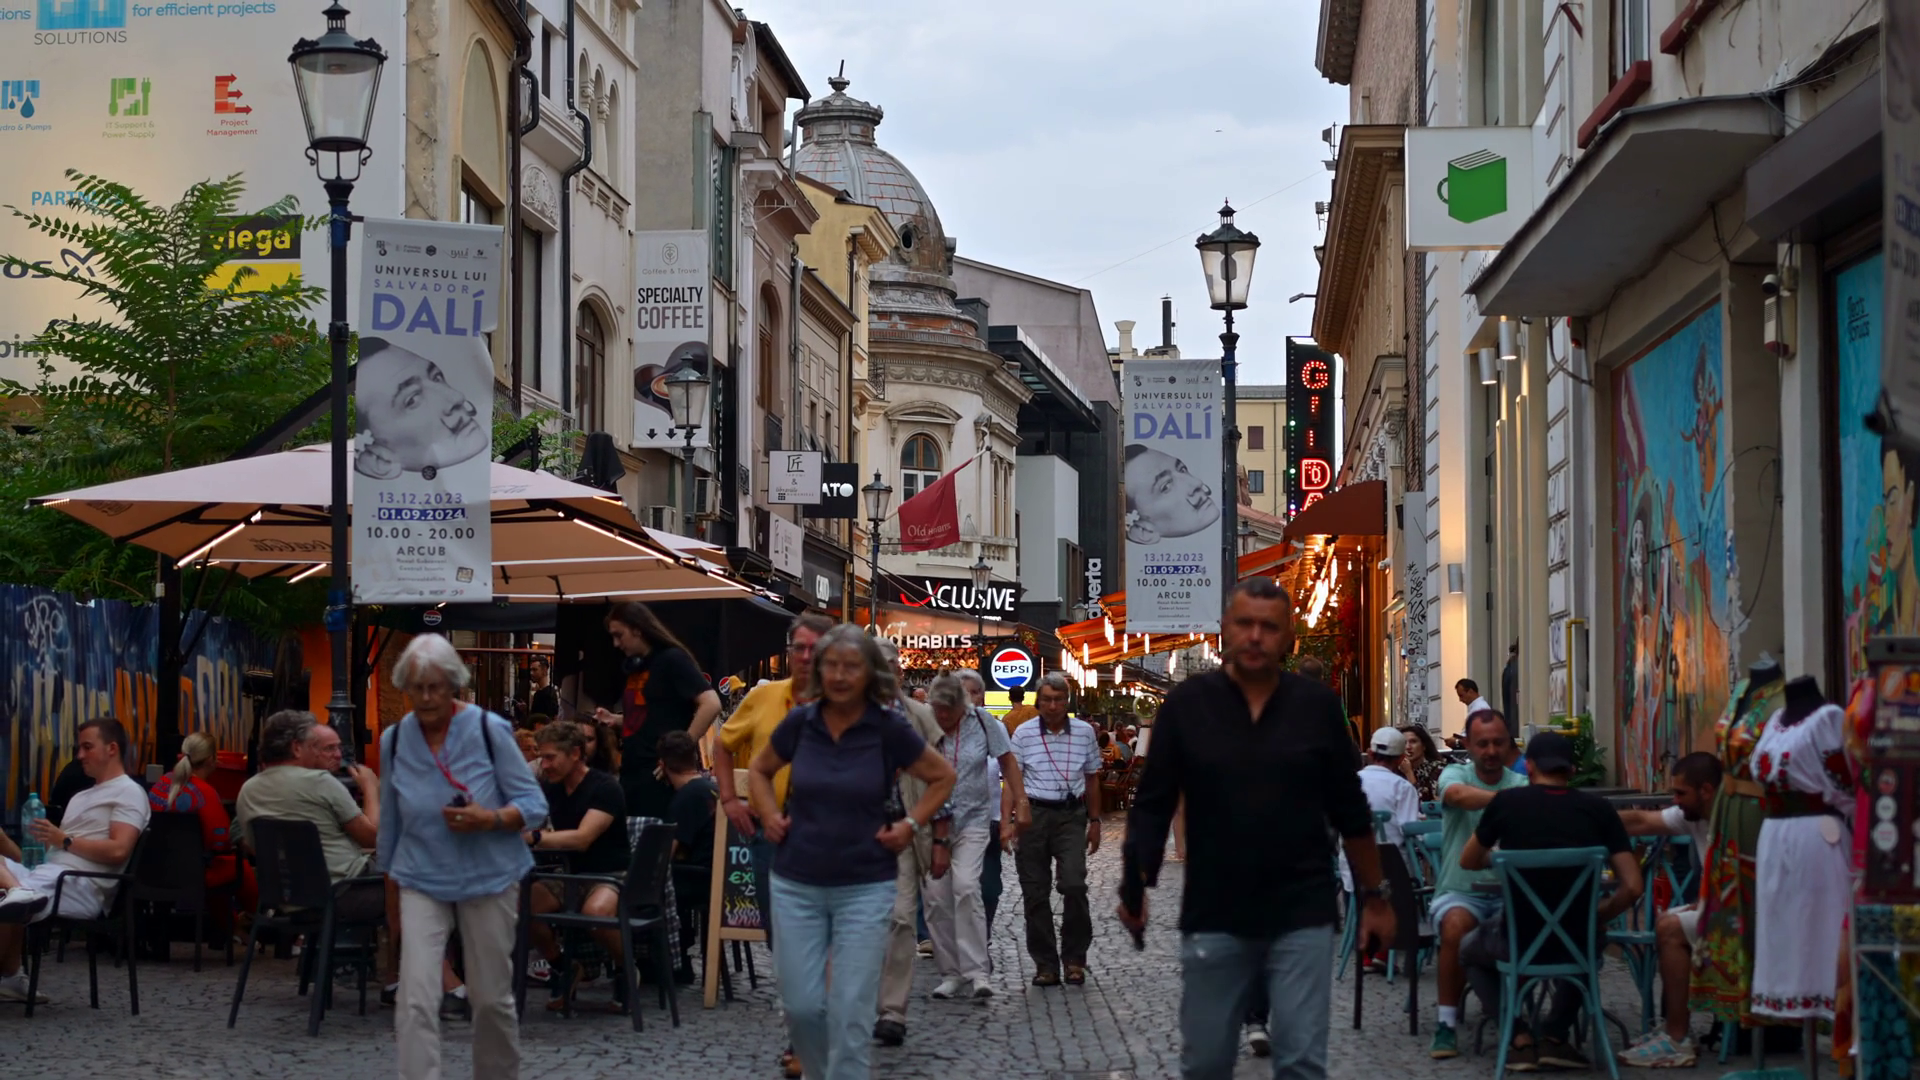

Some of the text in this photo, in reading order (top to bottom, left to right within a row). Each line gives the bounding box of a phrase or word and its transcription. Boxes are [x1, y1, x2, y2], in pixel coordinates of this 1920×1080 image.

[132, 2, 276, 17] for efficient projects
[34, 31, 127, 45] SOLUTIONS
[25, 124, 52, 132] Pumps
[115, 121, 147, 129] Support
[220, 119, 248, 127] Project
[207, 129, 258, 137] Management
[32, 191, 124, 206] PARTN
[375, 265, 487, 281] UNIVERSUL LUI
[642, 267, 667, 275] Coffee
[678, 267, 700, 275] Travel
[374, 279, 469, 294] SALVADOR
[638, 287, 703, 304] SPECIALTY
[372, 289, 485, 337] DALÍ
[638, 305, 703, 330] COFFEE
[1134, 405, 1212, 439] DALÍ
[379, 492, 462, 504] 13.12.2023
[380, 509, 464, 520] 01.09.2024
[367, 527, 410, 539] 10.00
[429, 528, 475, 539] 20.00
[907, 523, 926, 537] Old
[396, 546, 446, 556] ARCUB
[1144, 553, 1204, 562] 13.12.2023
[1145, 566, 1206, 575] 01.09.202
[1137, 578, 1167, 587] 10.00
[1179, 578, 1211, 587] 20.00
[906, 634, 972, 649] HABITS
[994, 665, 1029, 674] PEPSI
